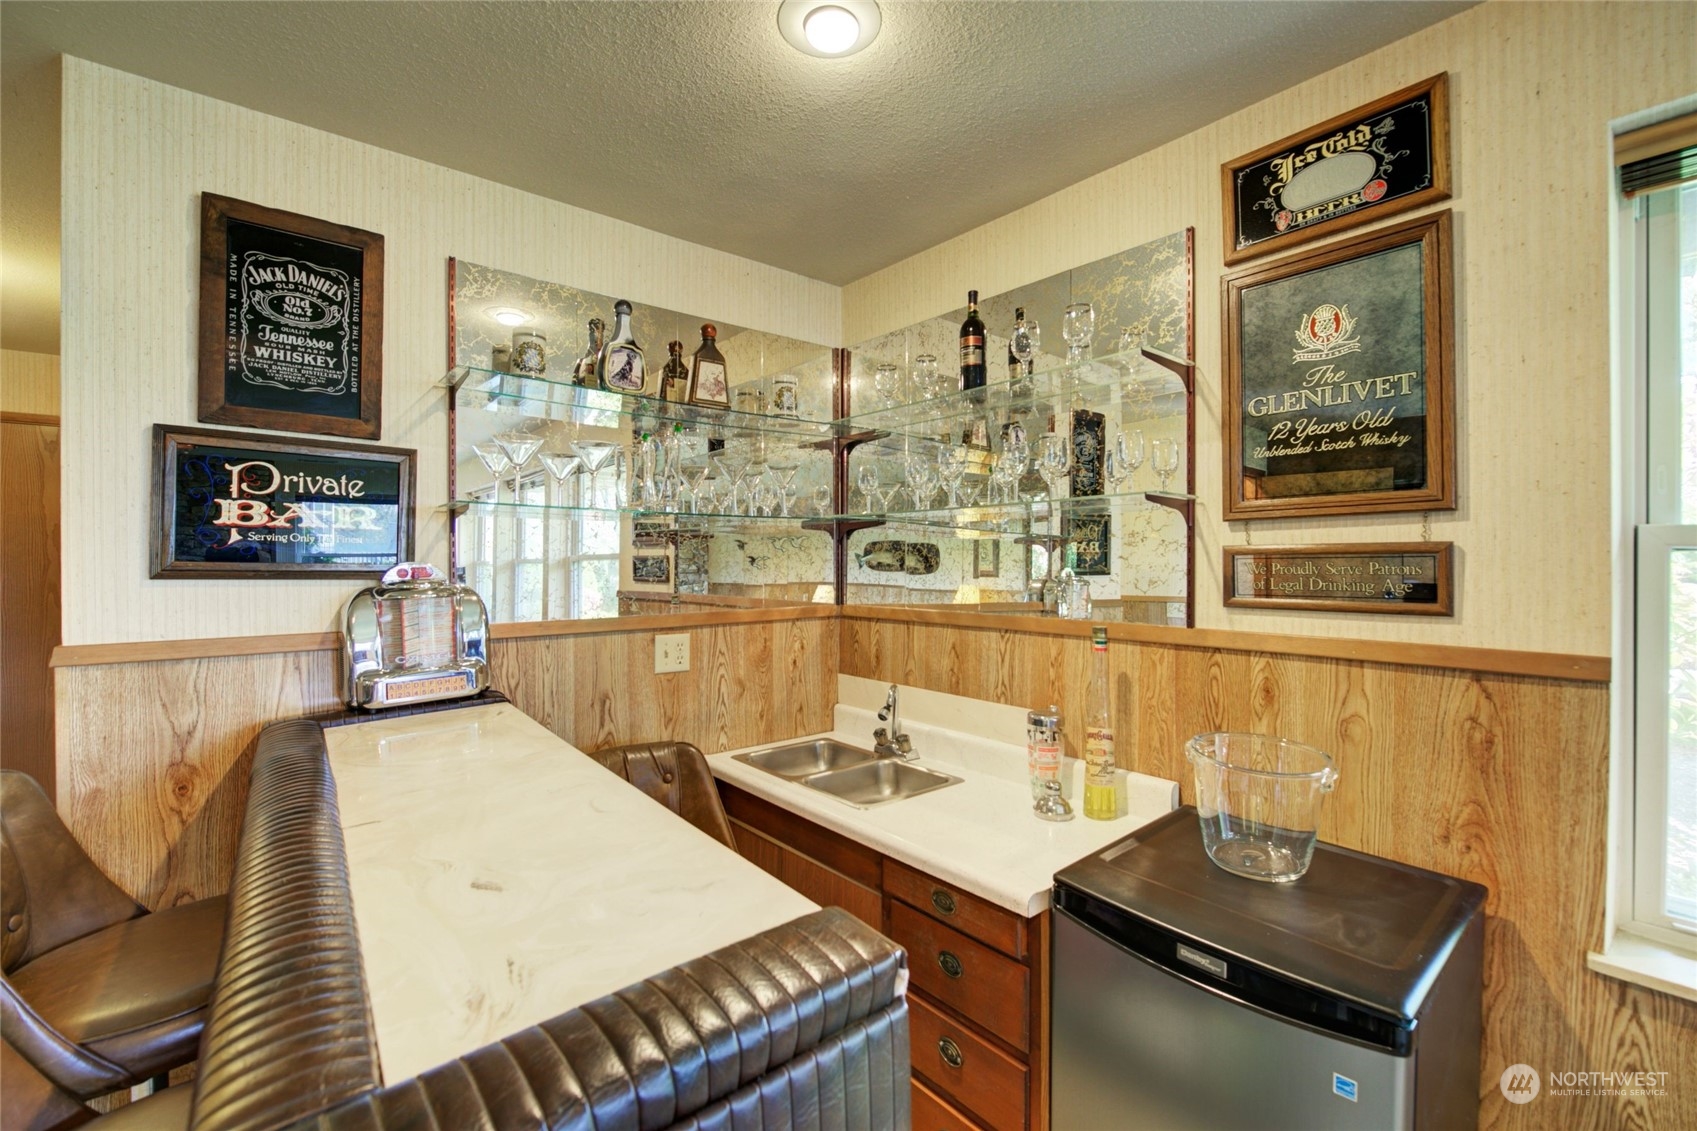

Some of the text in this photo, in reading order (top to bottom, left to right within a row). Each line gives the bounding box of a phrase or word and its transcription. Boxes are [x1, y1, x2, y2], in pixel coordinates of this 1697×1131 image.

[1304, 124, 1373, 158] Cold
[229, 288, 237, 299] IN
[248, 264, 346, 301] JACK DANIEL'S
[298, 285, 320, 296] TIME
[284, 296, 310, 308] Old
[284, 313, 310, 322] BRAND
[228, 307, 237, 371] TENNESSEE
[258, 324, 334, 351] Tennessee
[281, 327, 310, 336] QUALITY
[253, 346, 337, 368] WHISKEY
[298, 346, 325, 355] MASH
[352, 342, 359, 352] AT
[248, 361, 342, 379] JACK DANIEL DISTILLERY
[351, 356, 359, 393] BOTTLED
[1303, 364, 1347, 387] The
[1247, 371, 1417, 417] GLENLIVET
[1267, 406, 1397, 444] 12 Years Old
[1253, 430, 1412, 459] Unblended Scotch Whisky
[224, 460, 366, 499] Private
[212, 498, 382, 530] BAR
[247, 532, 288, 543] Serving
[290, 533, 315, 545] Only
[1246, 561, 1423, 579] We Proudly Serve Patrons
[1253, 577, 1414, 595] of Legal Drinking Age
